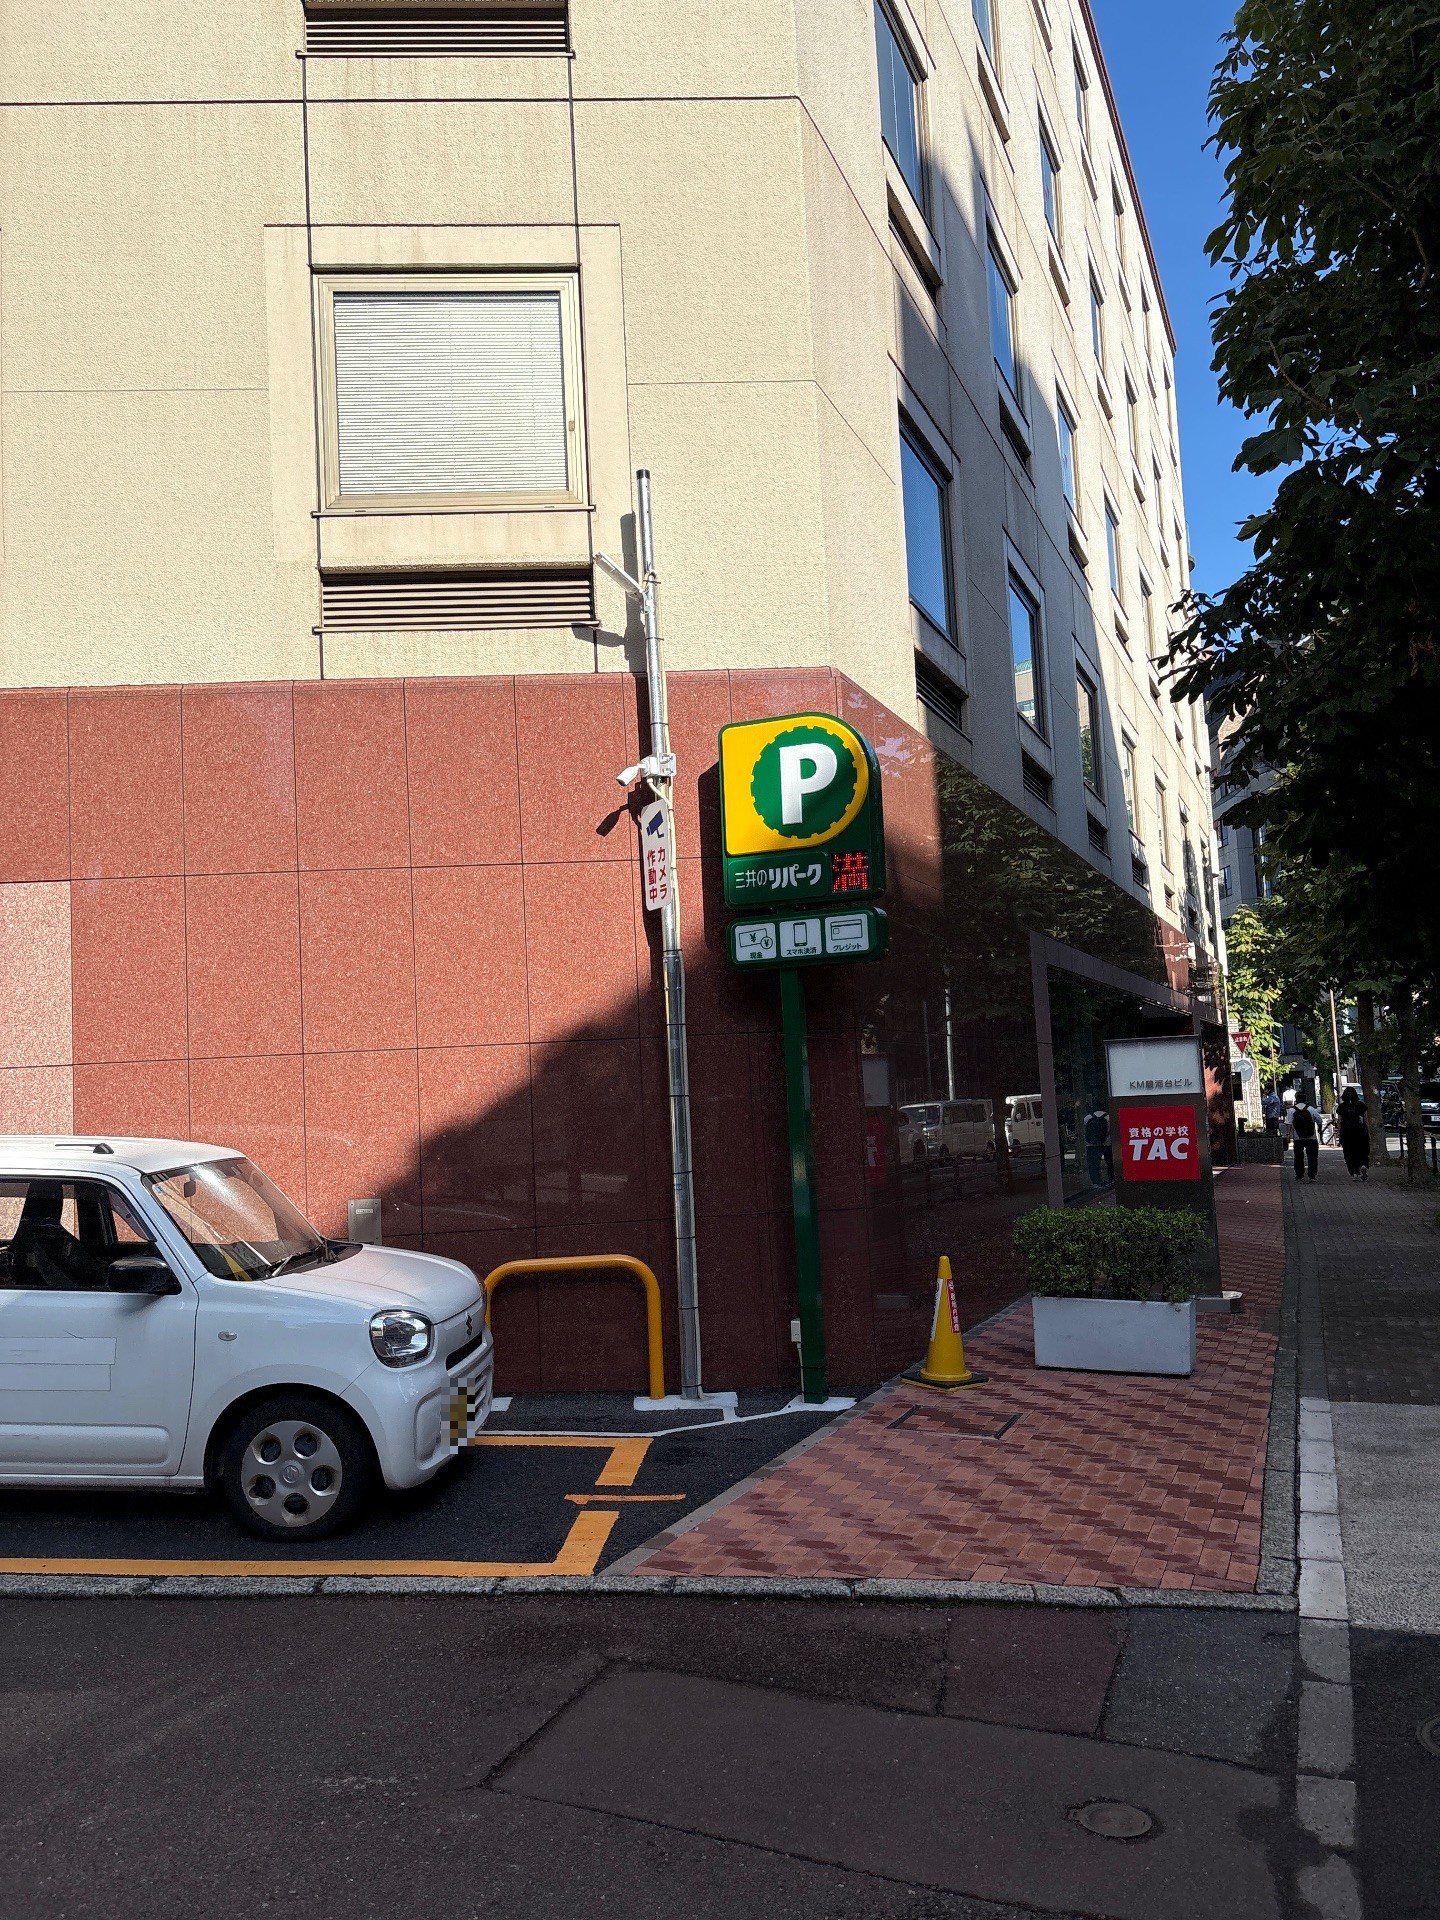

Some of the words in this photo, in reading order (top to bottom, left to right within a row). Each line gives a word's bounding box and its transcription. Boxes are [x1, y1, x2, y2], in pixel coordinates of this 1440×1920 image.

[779, 743, 837, 825] P
[647, 849, 658, 903] 作動中
[657, 847, 667, 899] カメラ
[735, 864, 822, 889] 三井のリパーク
[832, 852, 869, 892] 満
[786, 947, 817, 956] スマホ決済
[1129, 1126, 1189, 1138] 資格の学校
[1129, 1138, 1190, 1161] TAC
